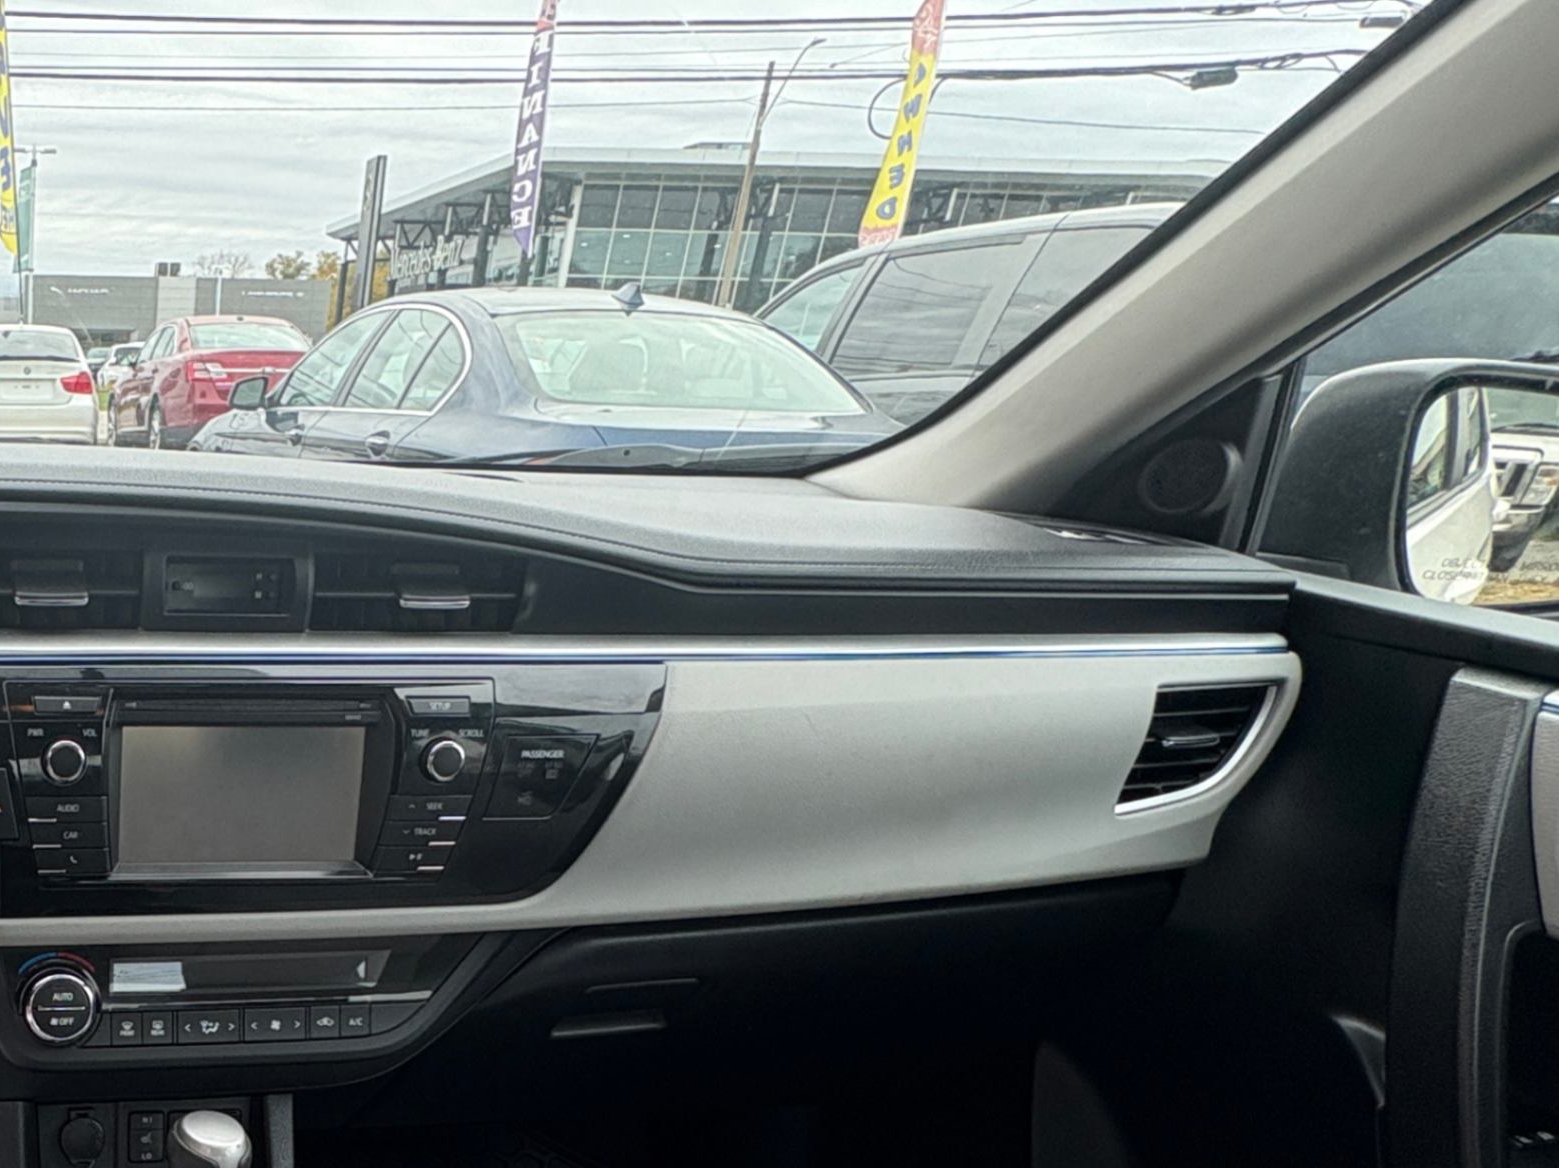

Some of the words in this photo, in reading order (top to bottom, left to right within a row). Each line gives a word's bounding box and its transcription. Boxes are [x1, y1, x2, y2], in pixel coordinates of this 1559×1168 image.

[27, 728, 44, 737] PWR
[82, 729, 98, 737] VOL
[410, 729, 430, 738] TUNE
[458, 729, 484, 738] SCROLL
[521, 749, 564, 759] PASSENGER
[56, 803, 80, 812] AUDIO
[426, 802, 444, 811] SEEK
[63, 831, 79, 840] CAR
[413, 827, 437, 836] TRACK
[52, 992, 74, 1002] AUTO
[59, 1017, 75, 1027] OFF
[348, 1017, 364, 1027] A/C
